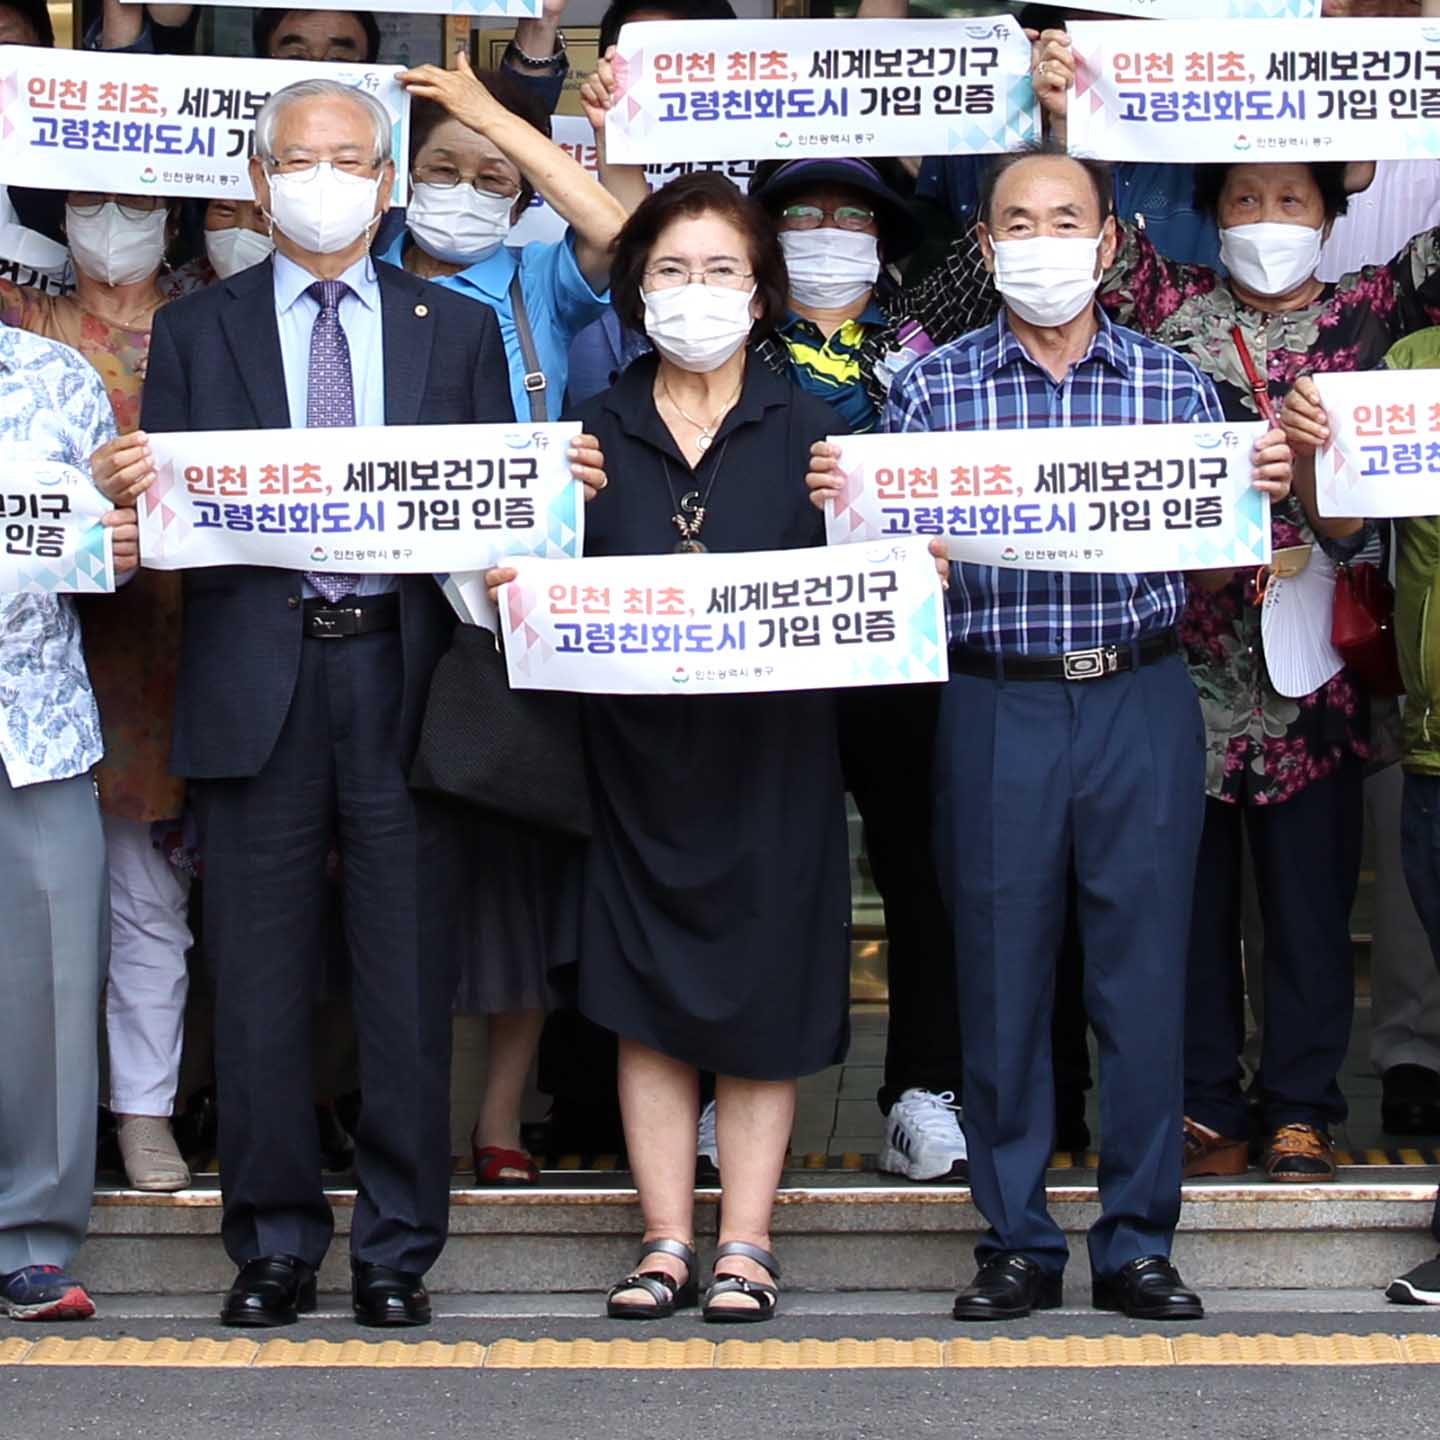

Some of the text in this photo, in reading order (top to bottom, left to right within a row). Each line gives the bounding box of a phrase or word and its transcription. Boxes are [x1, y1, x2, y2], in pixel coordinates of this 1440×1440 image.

[654, 47, 998, 84] 인천 최초, 세계보건기구
[1113, 53, 1173, 83] 인천
[1185, 51, 1255, 83] 최초,
[659, 84, 994, 122] 고령친화도시 가입 인증
[1119, 90, 1305, 122] 고령친화도시
[1318, 89, 1377, 120] 가입
[1354, 404, 1416, 436] 인천
[180, 458, 538, 496] 인천 최초, 세계보건기구
[875, 458, 1228, 499] 인천 최초, 세계보건기구
[192, 498, 534, 533] 고령친화도시 가입 인증
[882, 496, 1222, 536] 고령친화도시 가입 인증
[549, 571, 898, 615] 인천 최초, 세계보건기구
[554, 610, 895, 654] 고령친화도시 가입 인증
